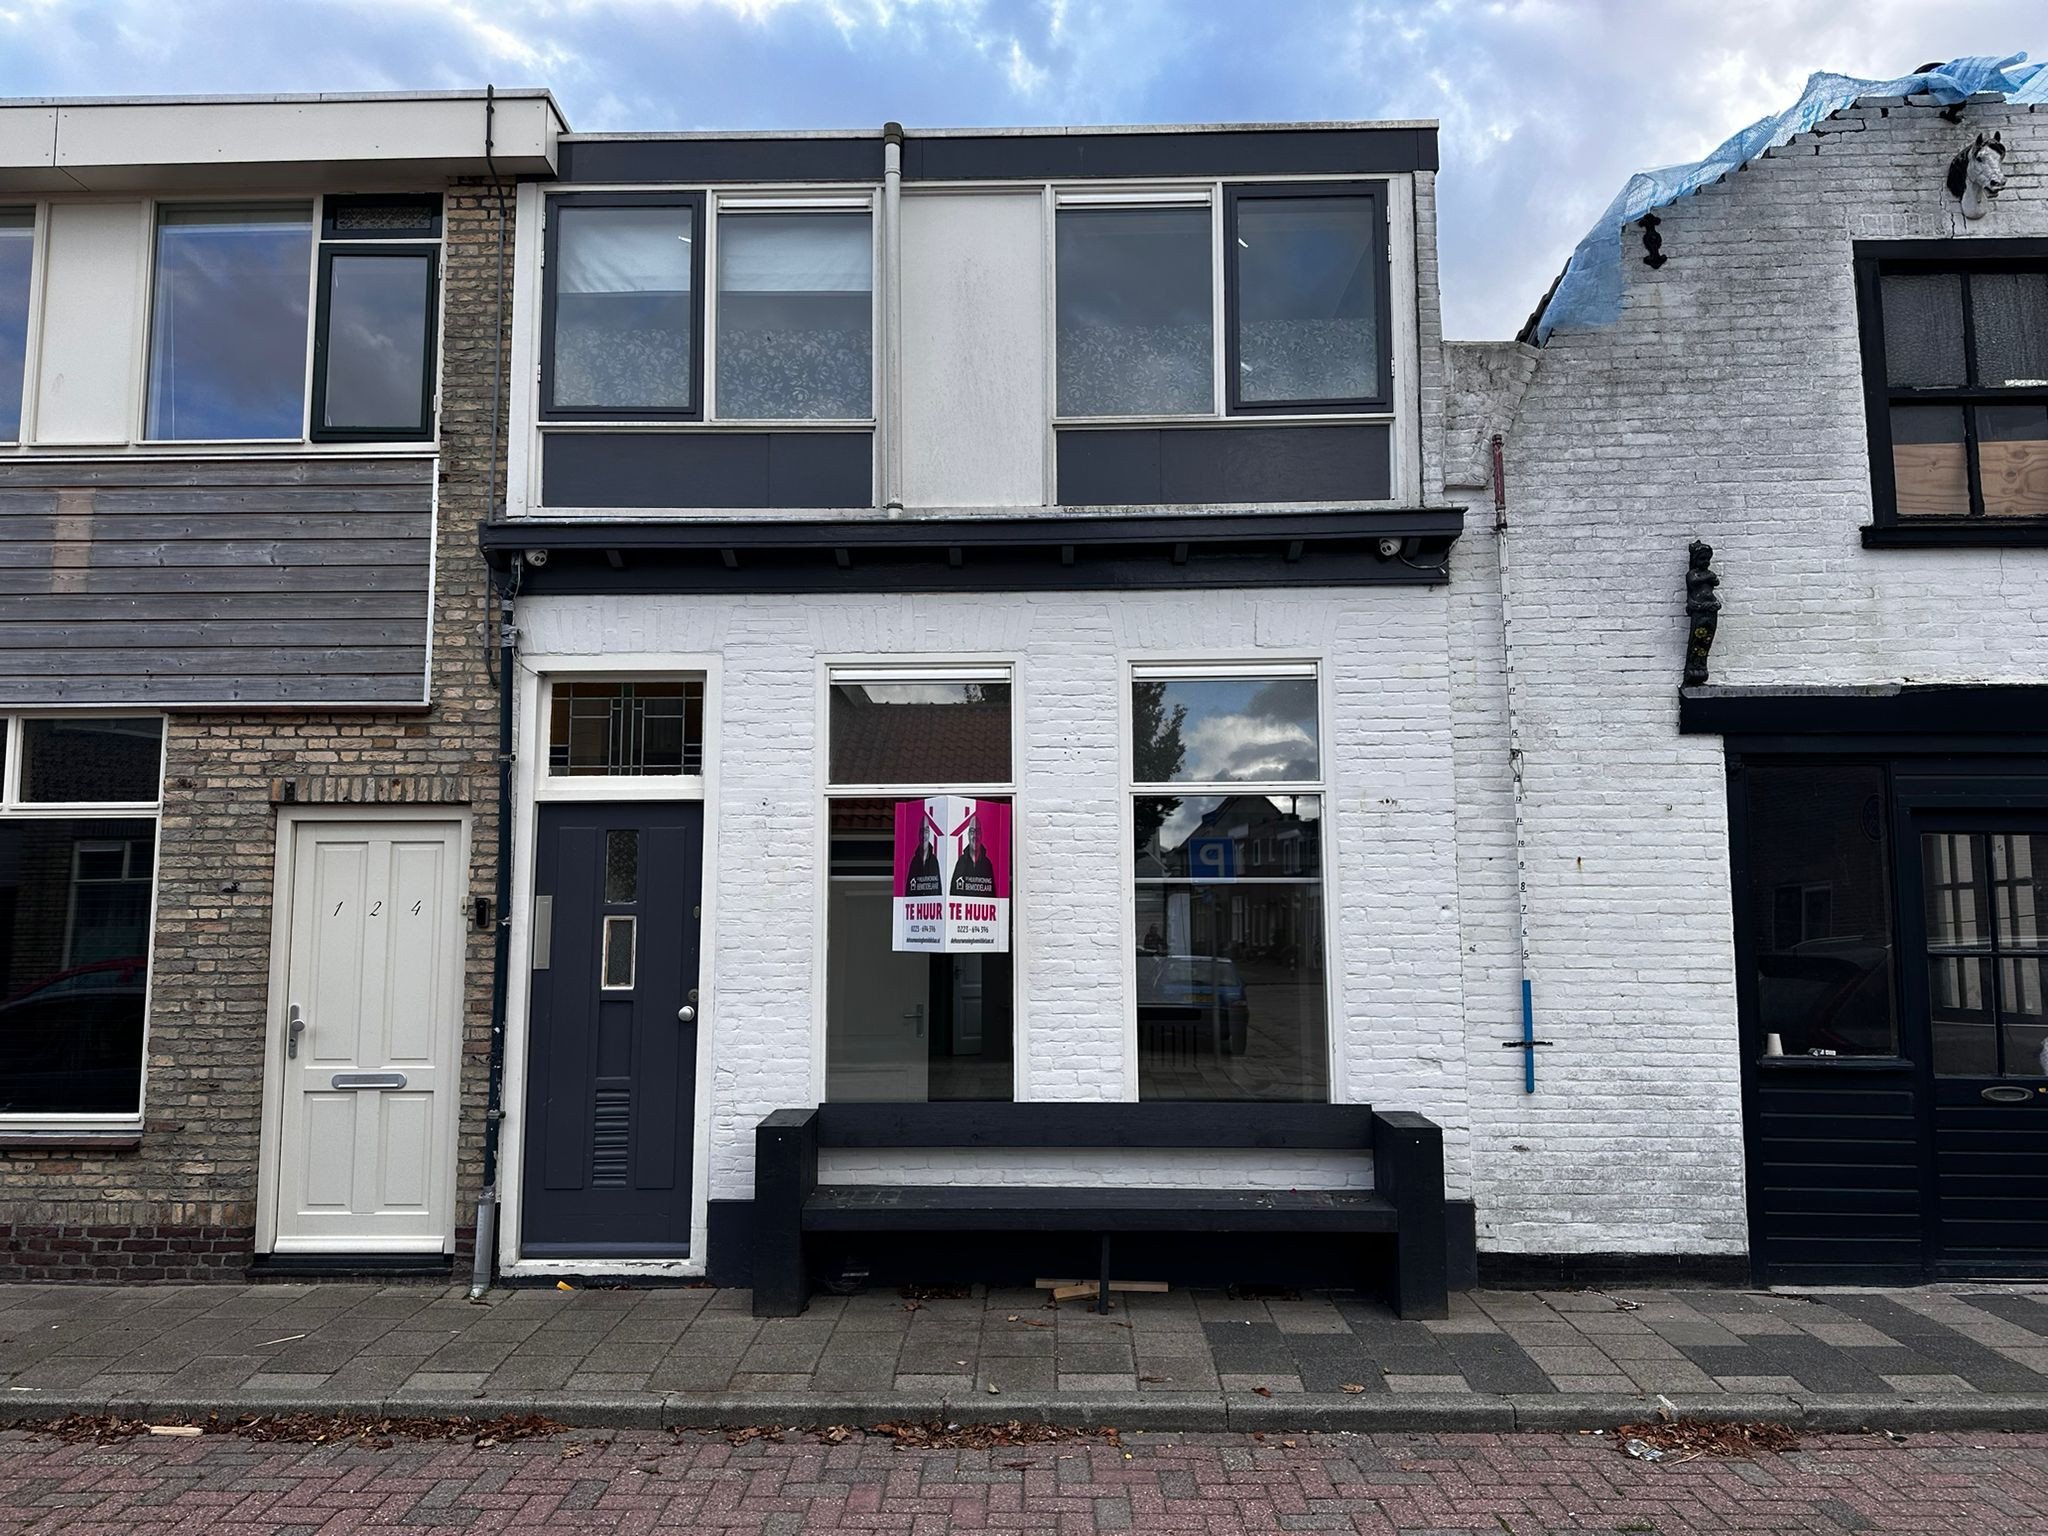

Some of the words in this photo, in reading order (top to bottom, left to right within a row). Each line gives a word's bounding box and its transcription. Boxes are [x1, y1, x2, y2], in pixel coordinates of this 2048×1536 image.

[1512, 729, 1518, 737] 15
[1520, 861, 1525, 869] 9
[1520, 881, 1526, 891] 8
[369, 900, 382, 917] 2
[411, 899, 421, 916] 4
[905, 903, 915, 920] TE
[916, 902, 942, 920] HUUR
[949, 903, 962, 920] TE
[965, 903, 996, 921] HUUR
[1521, 904, 1527, 912] 7
[1522, 927, 1528, 936] 6
[1523, 949, 1529, 958] 5
